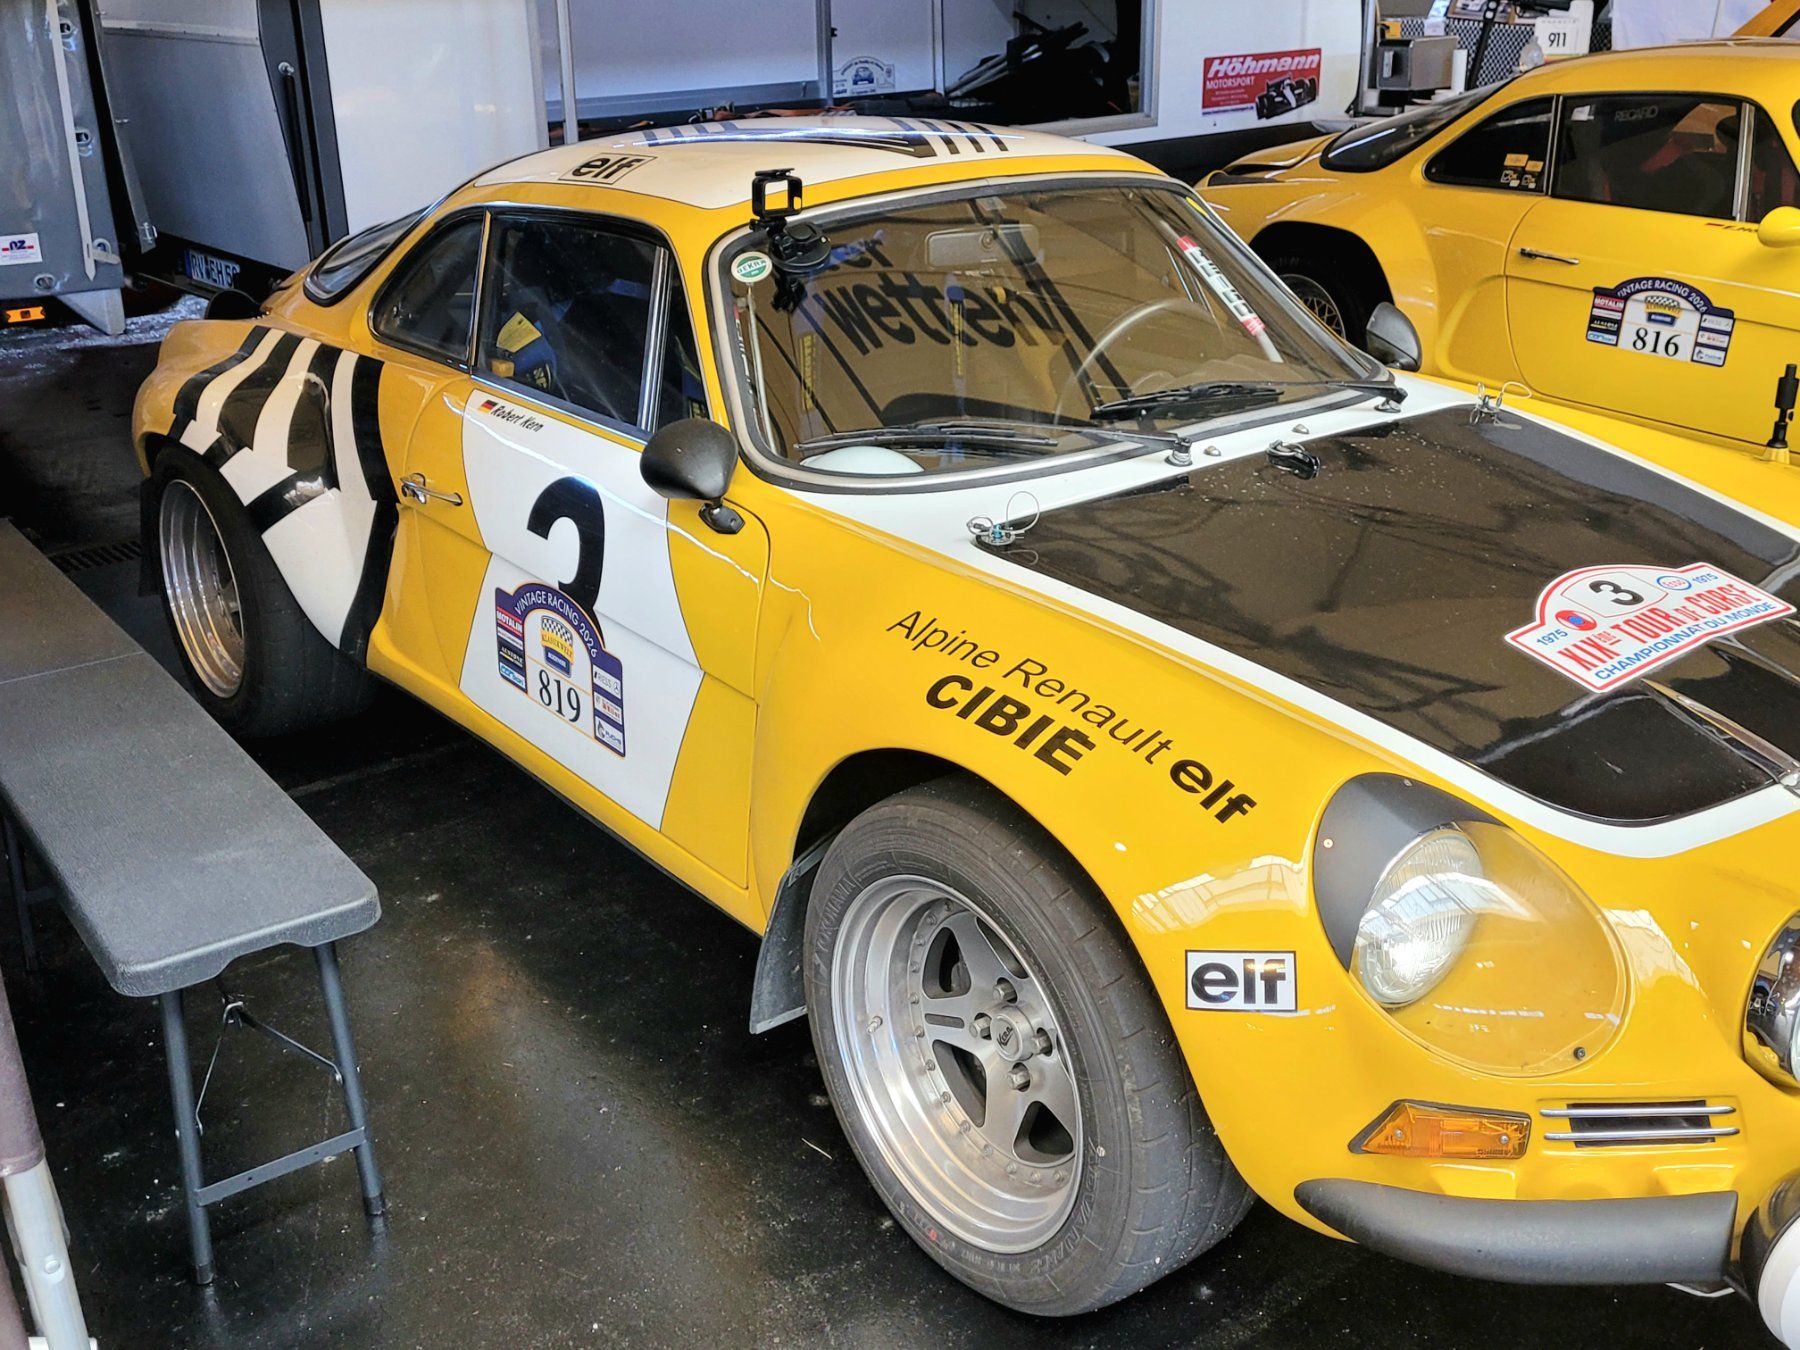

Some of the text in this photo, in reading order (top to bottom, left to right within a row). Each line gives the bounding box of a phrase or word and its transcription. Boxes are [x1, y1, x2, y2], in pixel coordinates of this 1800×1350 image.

[1548, 32, 1567, 48] 911
[1207, 54, 1320, 77] Höhmann
[1206, 76, 1255, 89] MOTORSPORT
[572, 157, 645, 179] elf
[736, 260, 767, 274] DEKRA
[1654, 279, 1689, 298] RACING
[1688, 292, 1709, 315] 2026
[1632, 327, 1682, 358] 816
[490, 405, 544, 432] Robert Kern
[1661, 579, 1686, 588] Esso
[1692, 573, 1719, 584] 1975
[1589, 580, 1645, 606] 3
[1683, 584, 1761, 615] CORSE
[497, 610, 523, 632] MOTALIN
[514, 590, 597, 659] VINTAGE RACING 2026
[1609, 607, 1687, 644] TOUR
[1672, 605, 1707, 621] DE
[1537, 629, 1568, 646] 1975
[1595, 601, 1777, 680] CHAMPIONNAT DU MONDE
[539, 669, 581, 723] 819
[886, 610, 1258, 824] Alpine Renault elf
[817, 877, 857, 952] YOKOHAMA
[1190, 958, 1286, 1005] elf
